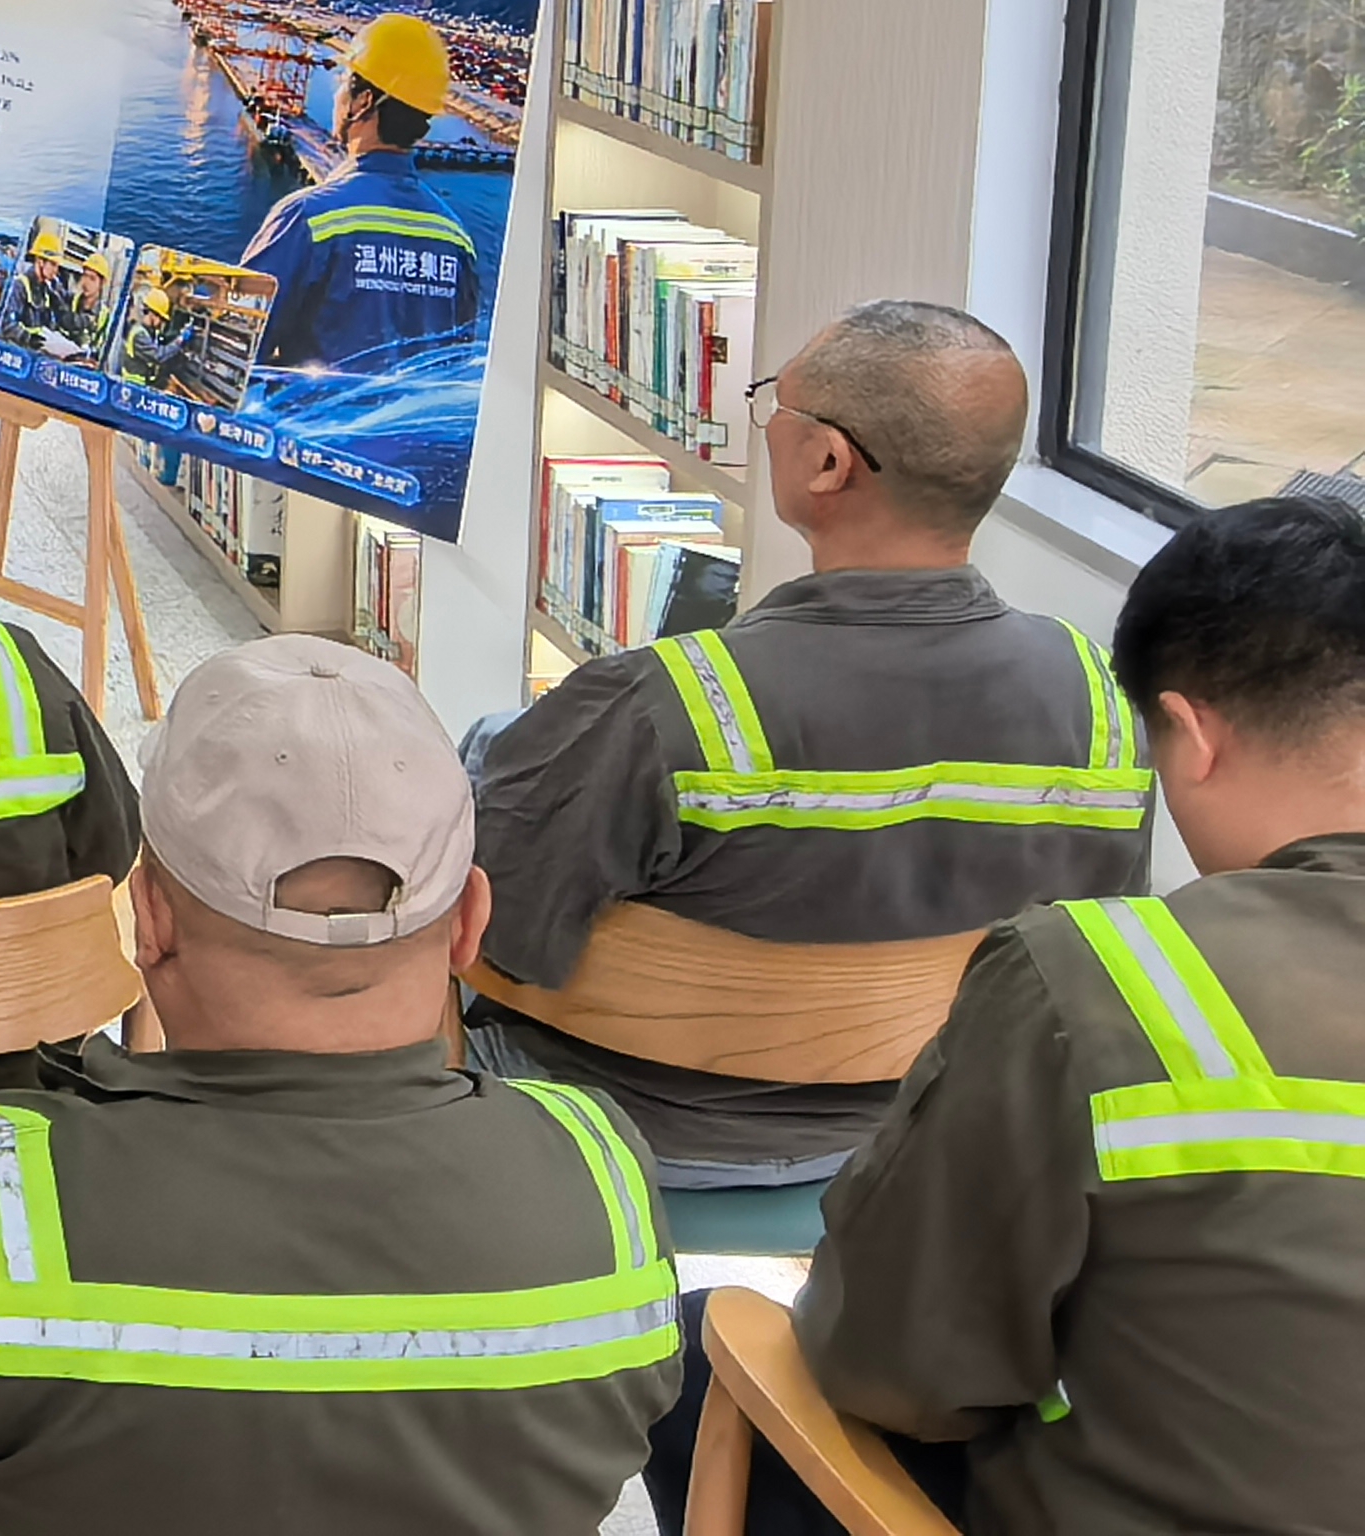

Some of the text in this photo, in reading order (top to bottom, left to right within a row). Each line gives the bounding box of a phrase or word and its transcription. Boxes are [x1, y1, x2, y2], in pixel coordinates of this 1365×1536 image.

[354, 244, 458, 285] 温州港集团
